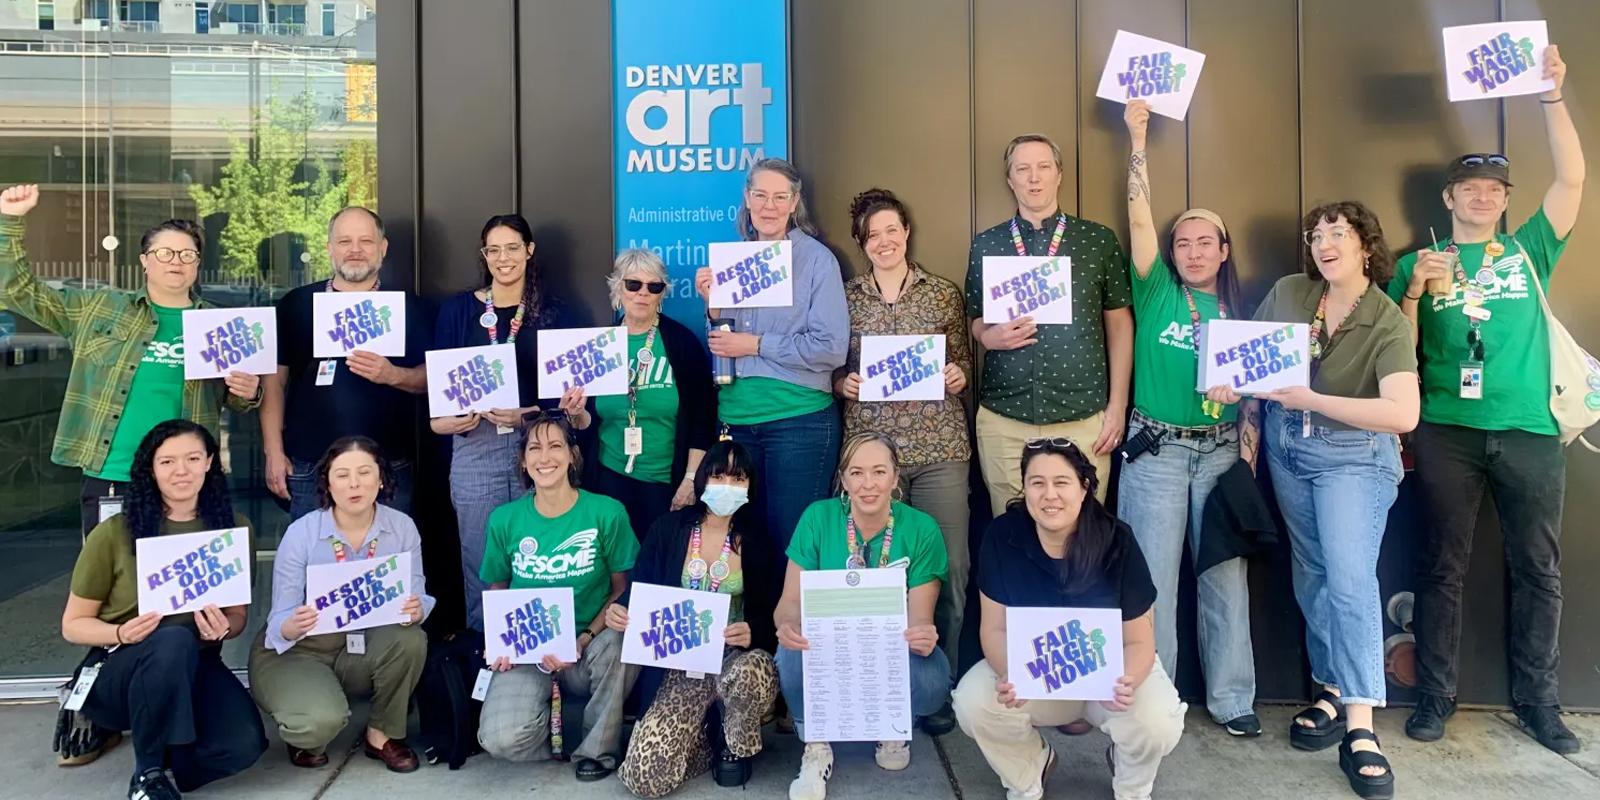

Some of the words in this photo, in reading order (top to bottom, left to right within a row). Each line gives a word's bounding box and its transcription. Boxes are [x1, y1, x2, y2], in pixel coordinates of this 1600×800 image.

[1129, 51, 1172, 71] FAIR
[1466, 32, 1517, 66] FAIR
[626, 63, 740, 87] DENVER
[1126, 77, 1181, 99] NOW!
[1480, 52, 1536, 93] NOW!
[626, 63, 772, 146] art
[626, 147, 765, 173] MUSEUM
[628, 206, 724, 223] Administrative
[716, 242, 781, 286] RESPECT
[738, 262, 772, 287] OUR
[990, 257, 1060, 300] RESPECT
[732, 265, 788, 305] LABOR!
[1007, 282, 1067, 321] LABOR!
[1014, 278, 1050, 303] OUR
[333, 299, 377, 325] FAIR
[205, 316, 250, 346] FAIR
[341, 317, 391, 352] NOW!
[1214, 324, 1295, 367] RESPECT
[215, 336, 265, 372] NOW!
[545, 328, 617, 375] RESPECT
[569, 350, 608, 376] OUR
[866, 336, 934, 379] RESPECT
[889, 356, 924, 380] OUR
[1232, 350, 1302, 388] LABOR!
[1242, 345, 1282, 370] OUR
[447, 354, 490, 385] FAIR
[882, 359, 940, 398] LABOR!
[457, 371, 505, 410] NOW!
[146, 530, 234, 591] RESPECT
[178, 556, 222, 588] OUR
[512, 548, 597, 573] AFSCME
[567, 566, 595, 577] Happen
[169, 557, 244, 611] LABOR!
[315, 555, 398, 611] RESPECT
[343, 580, 385, 609] OUR
[334, 580, 405, 629] LABOR!
[504, 597, 548, 628] FAIR
[649, 599, 698, 627] FAIR
[514, 619, 562, 658] NOW!
[653, 626, 711, 661] NOW!
[1031, 619, 1089, 656] FAIR
[1042, 648, 1107, 694] NOW!
